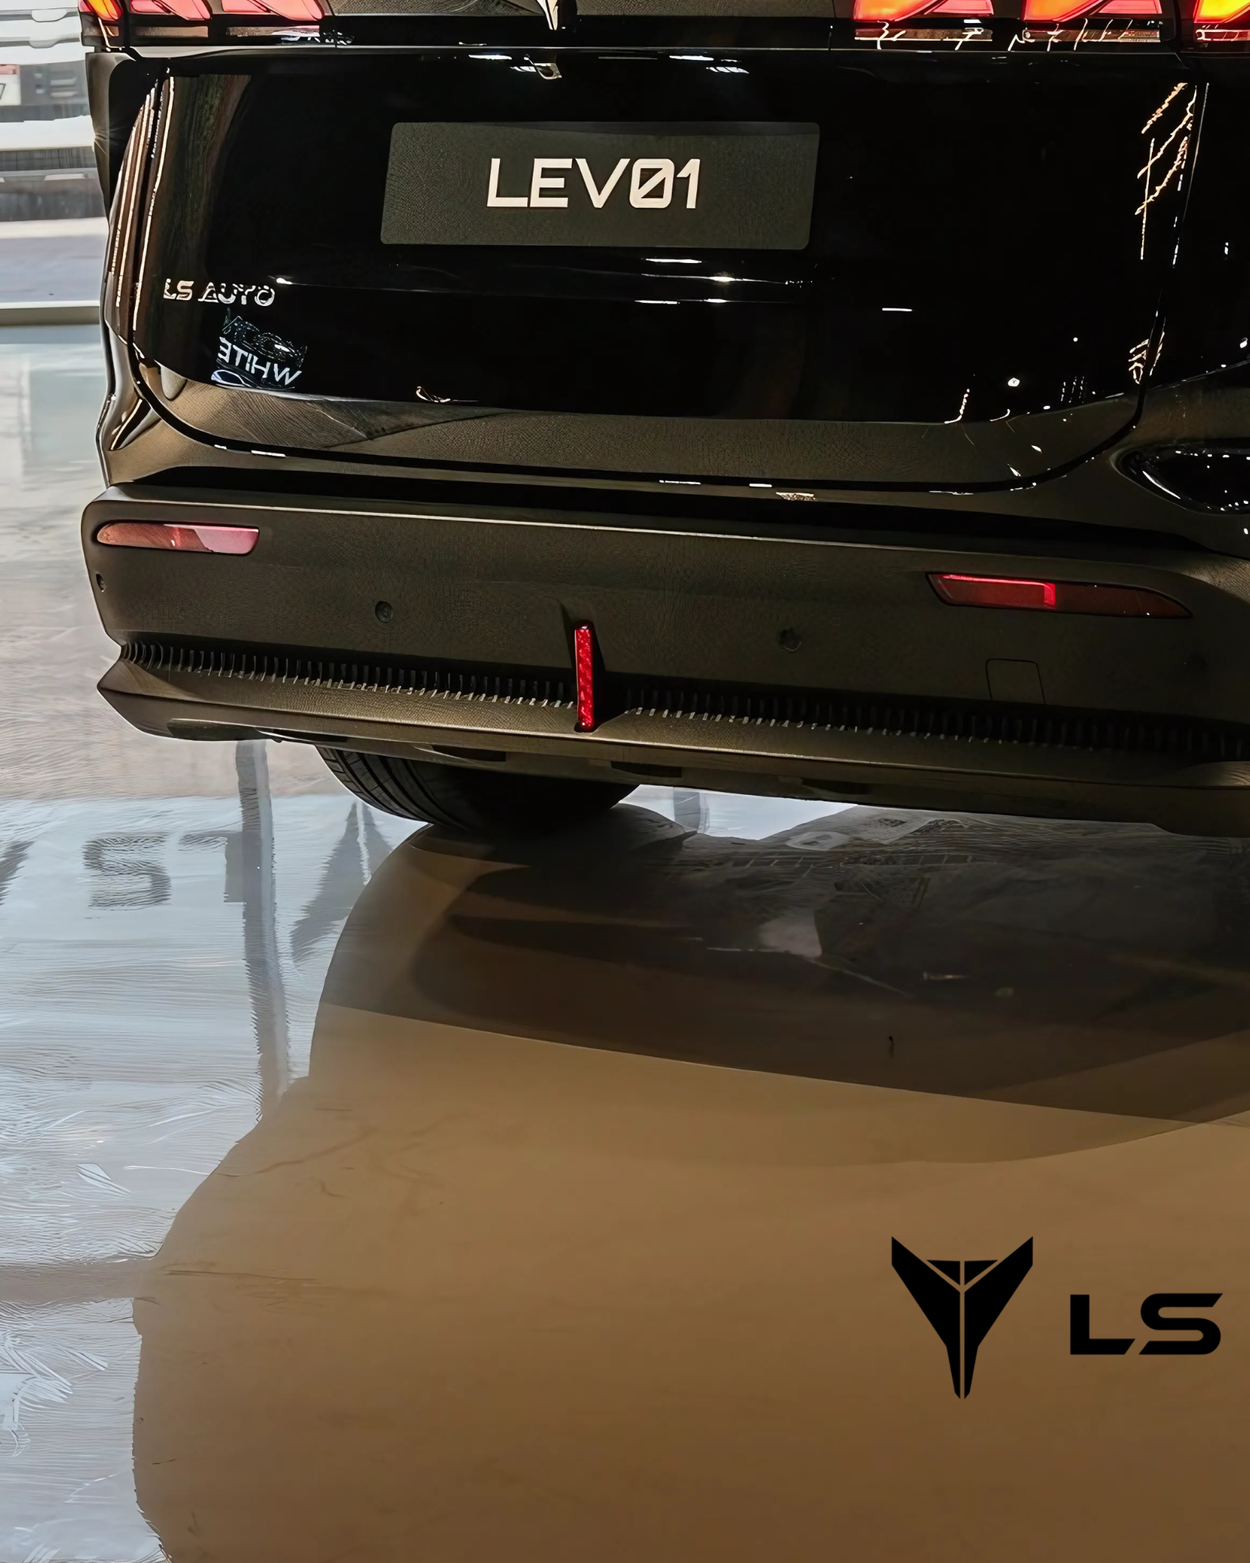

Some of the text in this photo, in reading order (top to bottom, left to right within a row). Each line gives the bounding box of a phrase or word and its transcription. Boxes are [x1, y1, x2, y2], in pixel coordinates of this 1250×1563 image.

[487, 157, 701, 209] LEV01
[163, 278, 276, 307] LS AUTO
